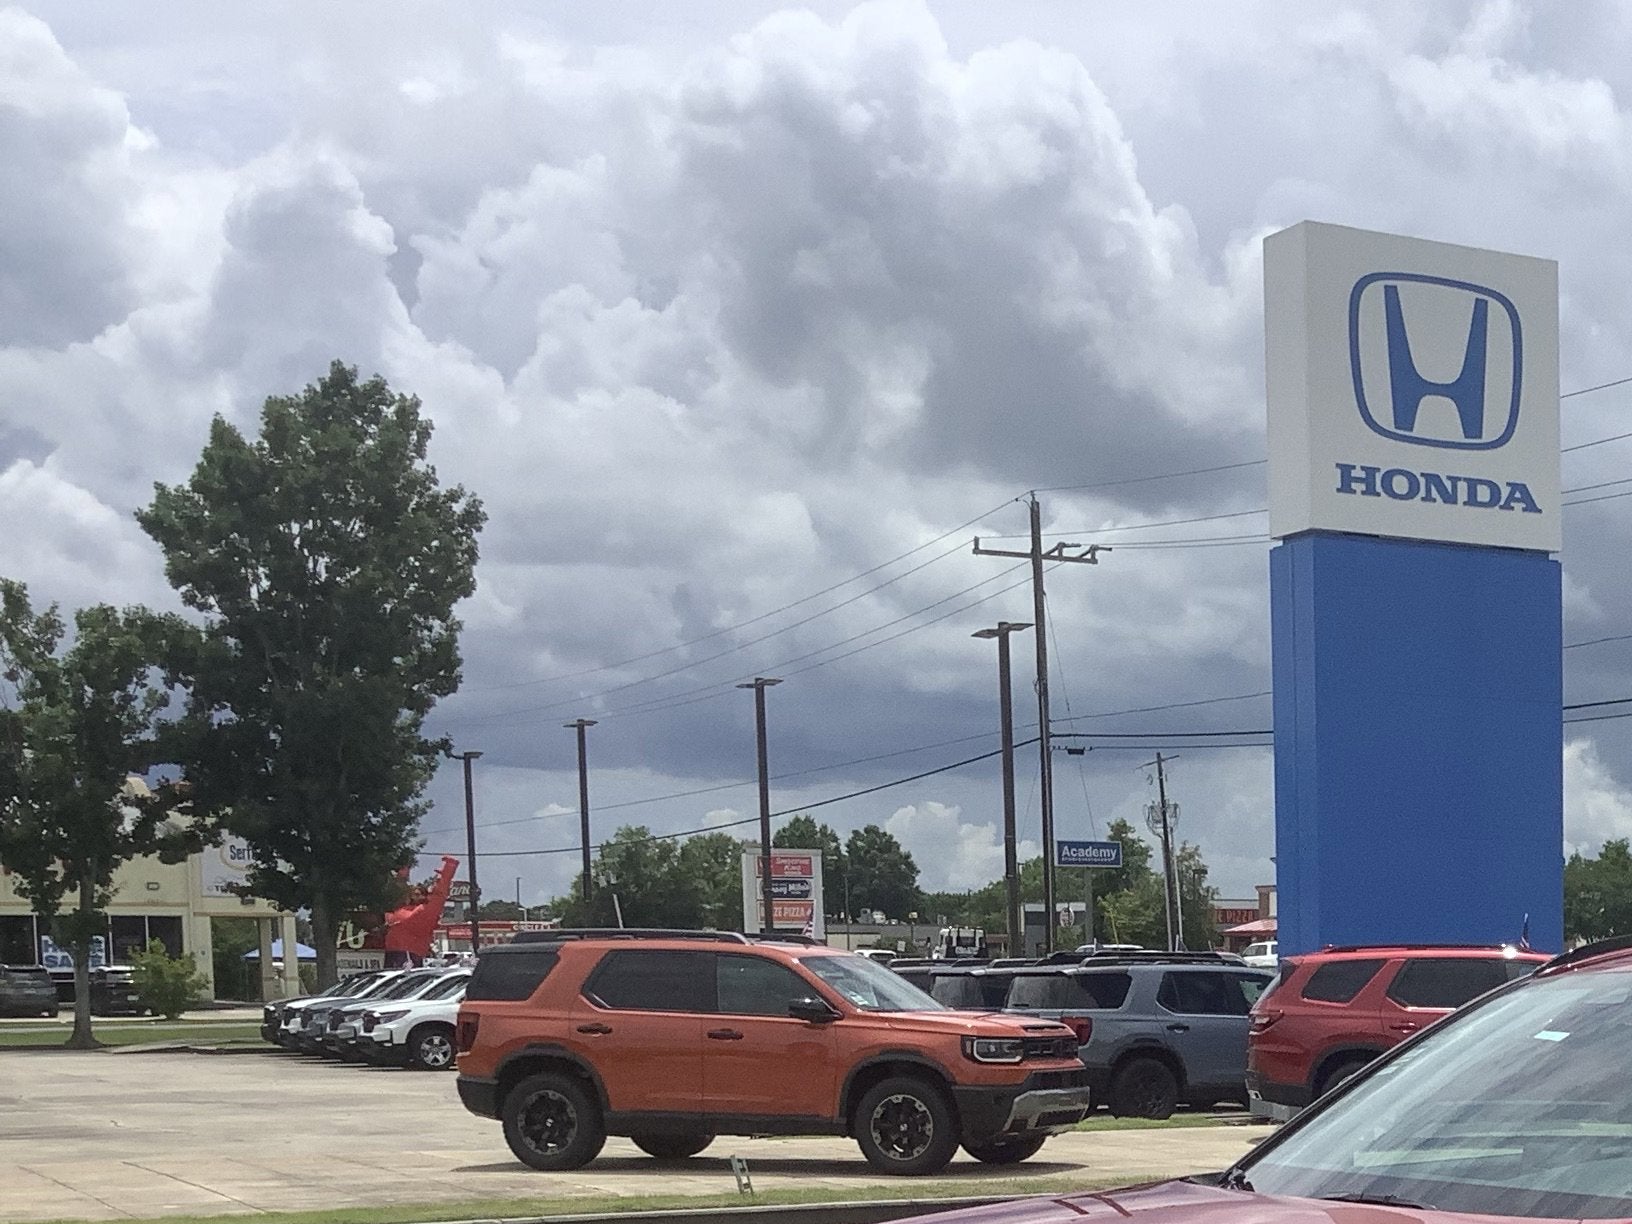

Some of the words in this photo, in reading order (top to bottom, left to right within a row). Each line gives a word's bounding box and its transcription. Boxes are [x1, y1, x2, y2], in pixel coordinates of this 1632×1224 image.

[1335, 462, 1543, 514] HONDA
[1061, 845, 1117, 861] Academy
[783, 907, 806, 918] PIZZA
